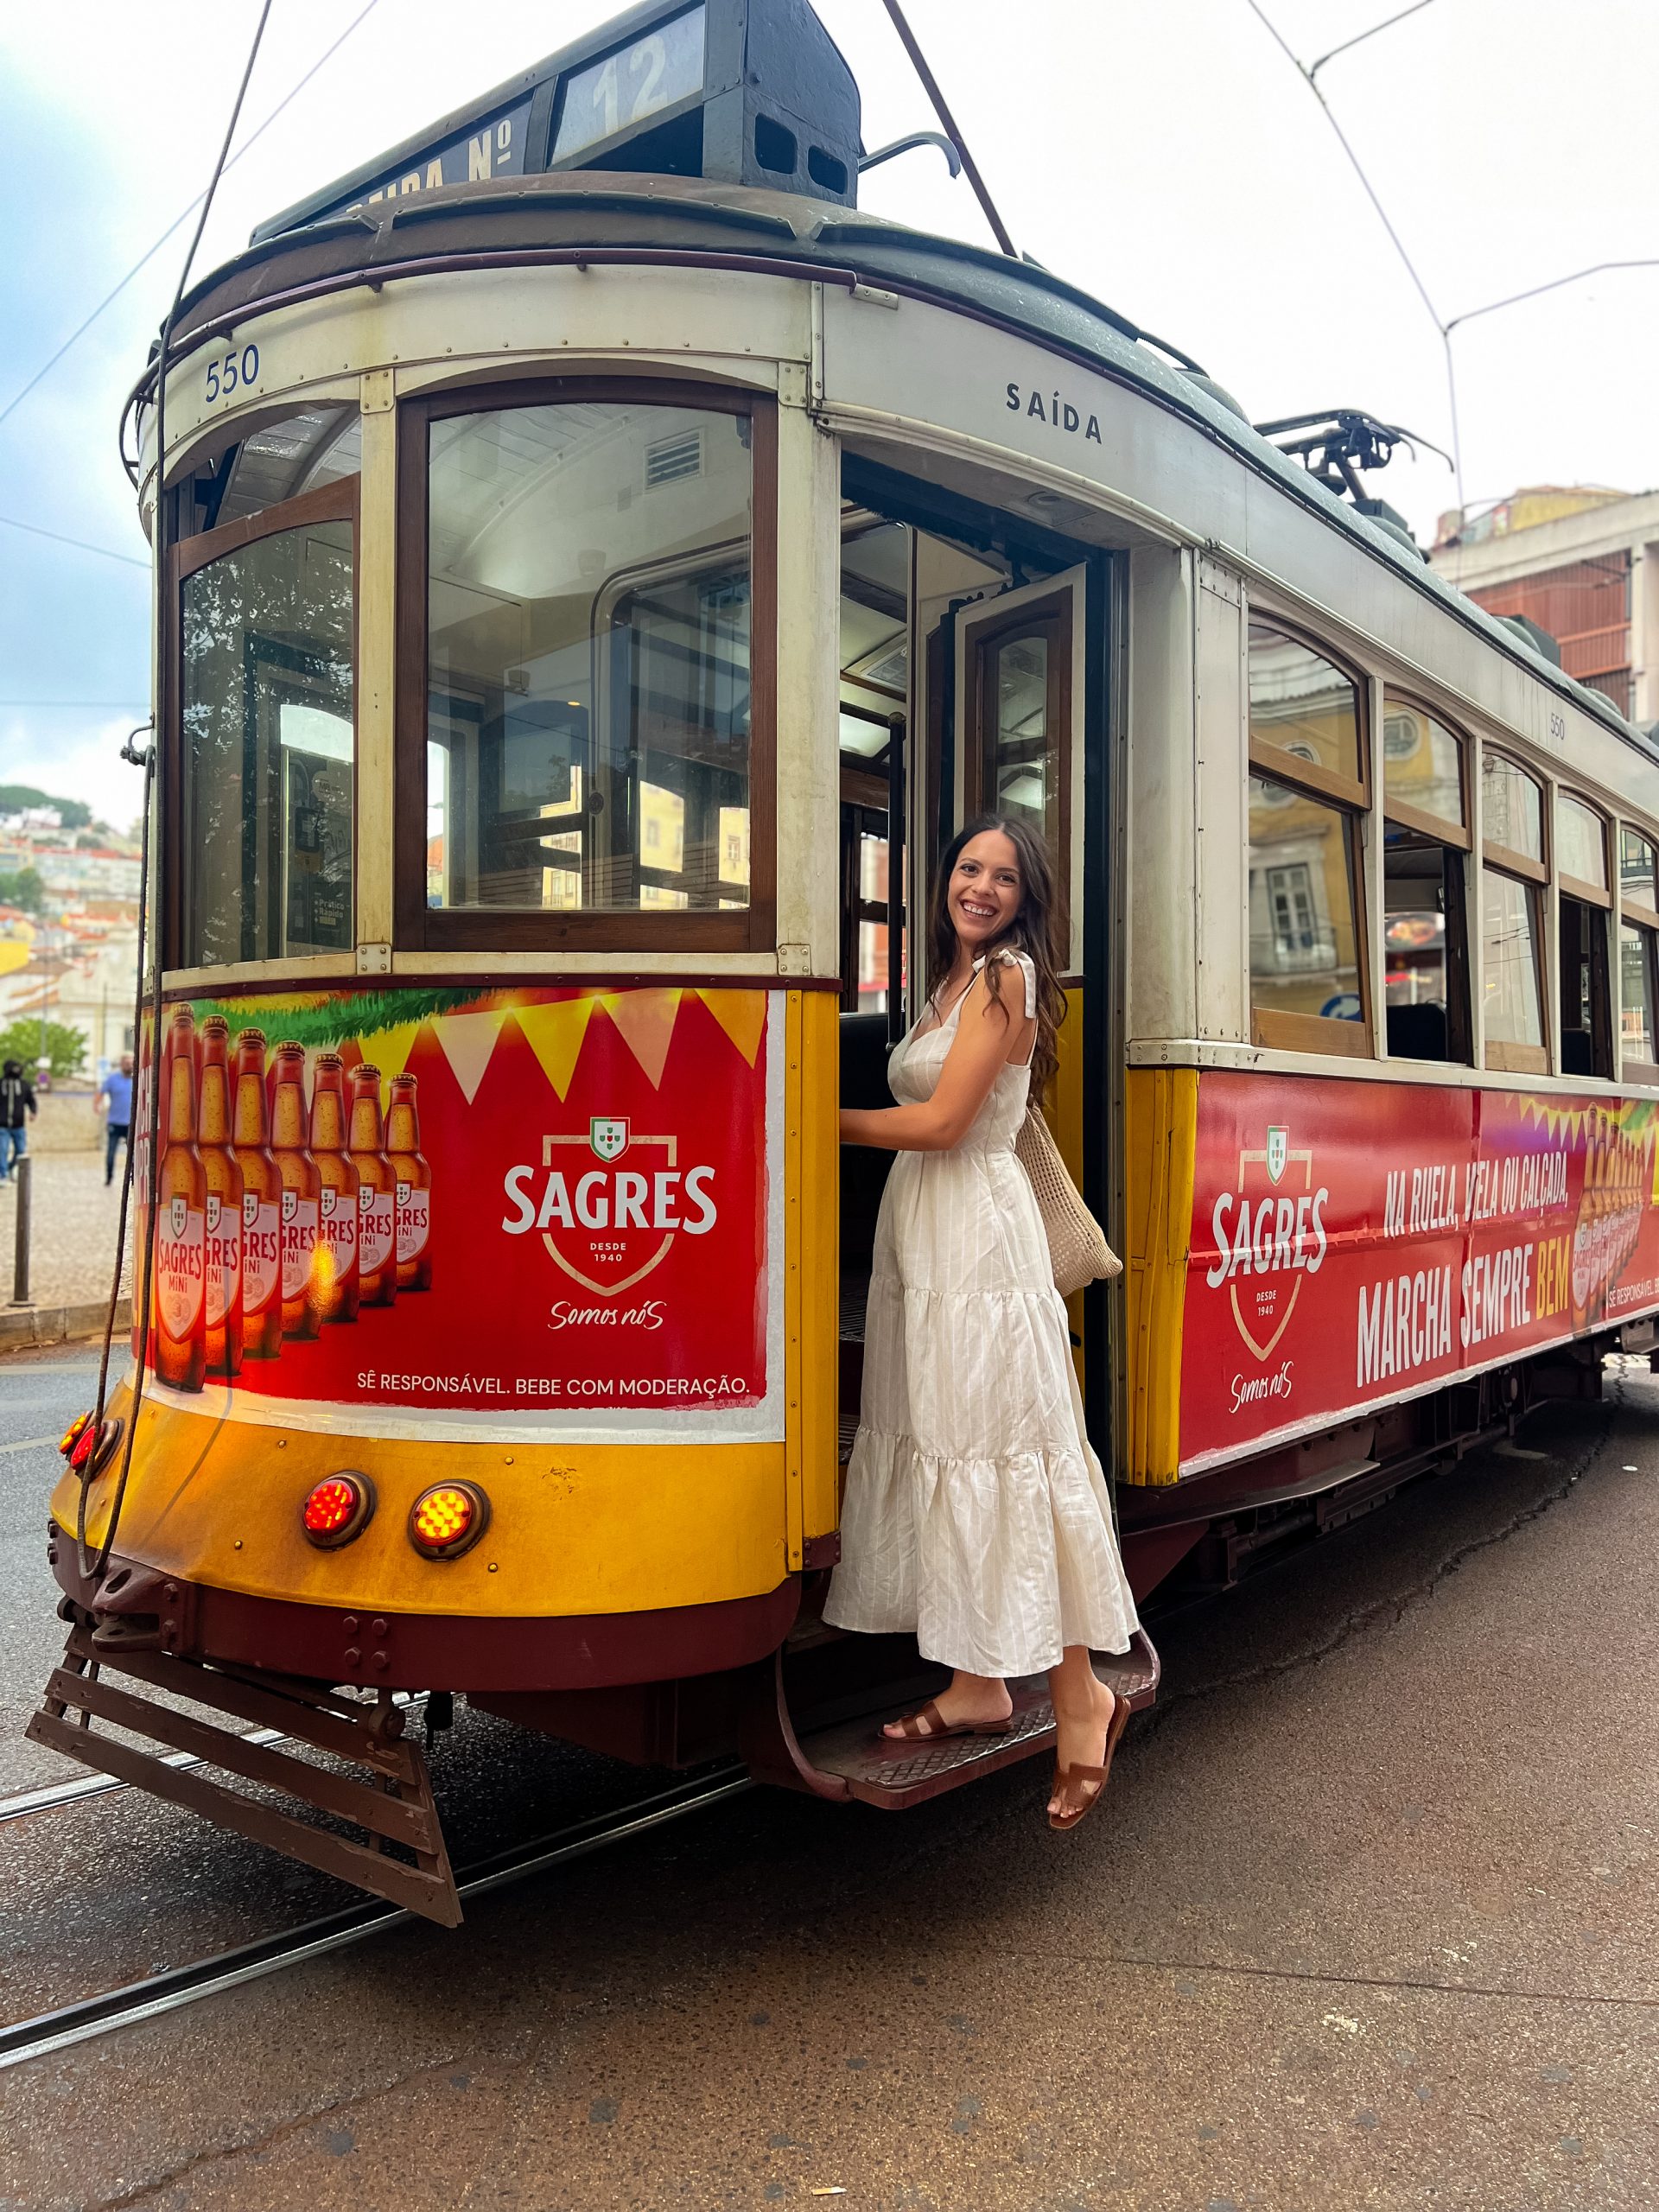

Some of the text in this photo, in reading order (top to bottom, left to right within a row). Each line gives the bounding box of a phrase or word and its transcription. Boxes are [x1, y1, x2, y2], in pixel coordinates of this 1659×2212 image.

[593, 35, 668, 137] 12
[206, 344, 259, 403] 550
[1006, 383, 1102, 445] SAÍDA
[1550, 712, 1565, 741] 550
[501, 1165, 717, 1234] SAGRES
[1384, 1170, 1407, 1238] NA
[1409, 1164, 1459, 1231] RUELA,
[1501, 1156, 1520, 1214] OU
[1520, 1151, 1568, 1217] CALÇADA,
[159, 1239, 201, 1281] SAGRES
[1206, 1187, 1329, 1288] SAGRES
[547, 1300, 618, 1330] Somos
[1255, 1289, 1277, 1302] DESDE
[1257, 1305, 1274, 1317] 1940
[1357, 1234, 1571, 1388] MARCHA SEMPRE BEM
[357, 1370, 750, 1399] SÊ RESPONSÁVEL. BEBE COM MODERAÇÃO.
[1229, 1373, 1269, 1414] Somos
